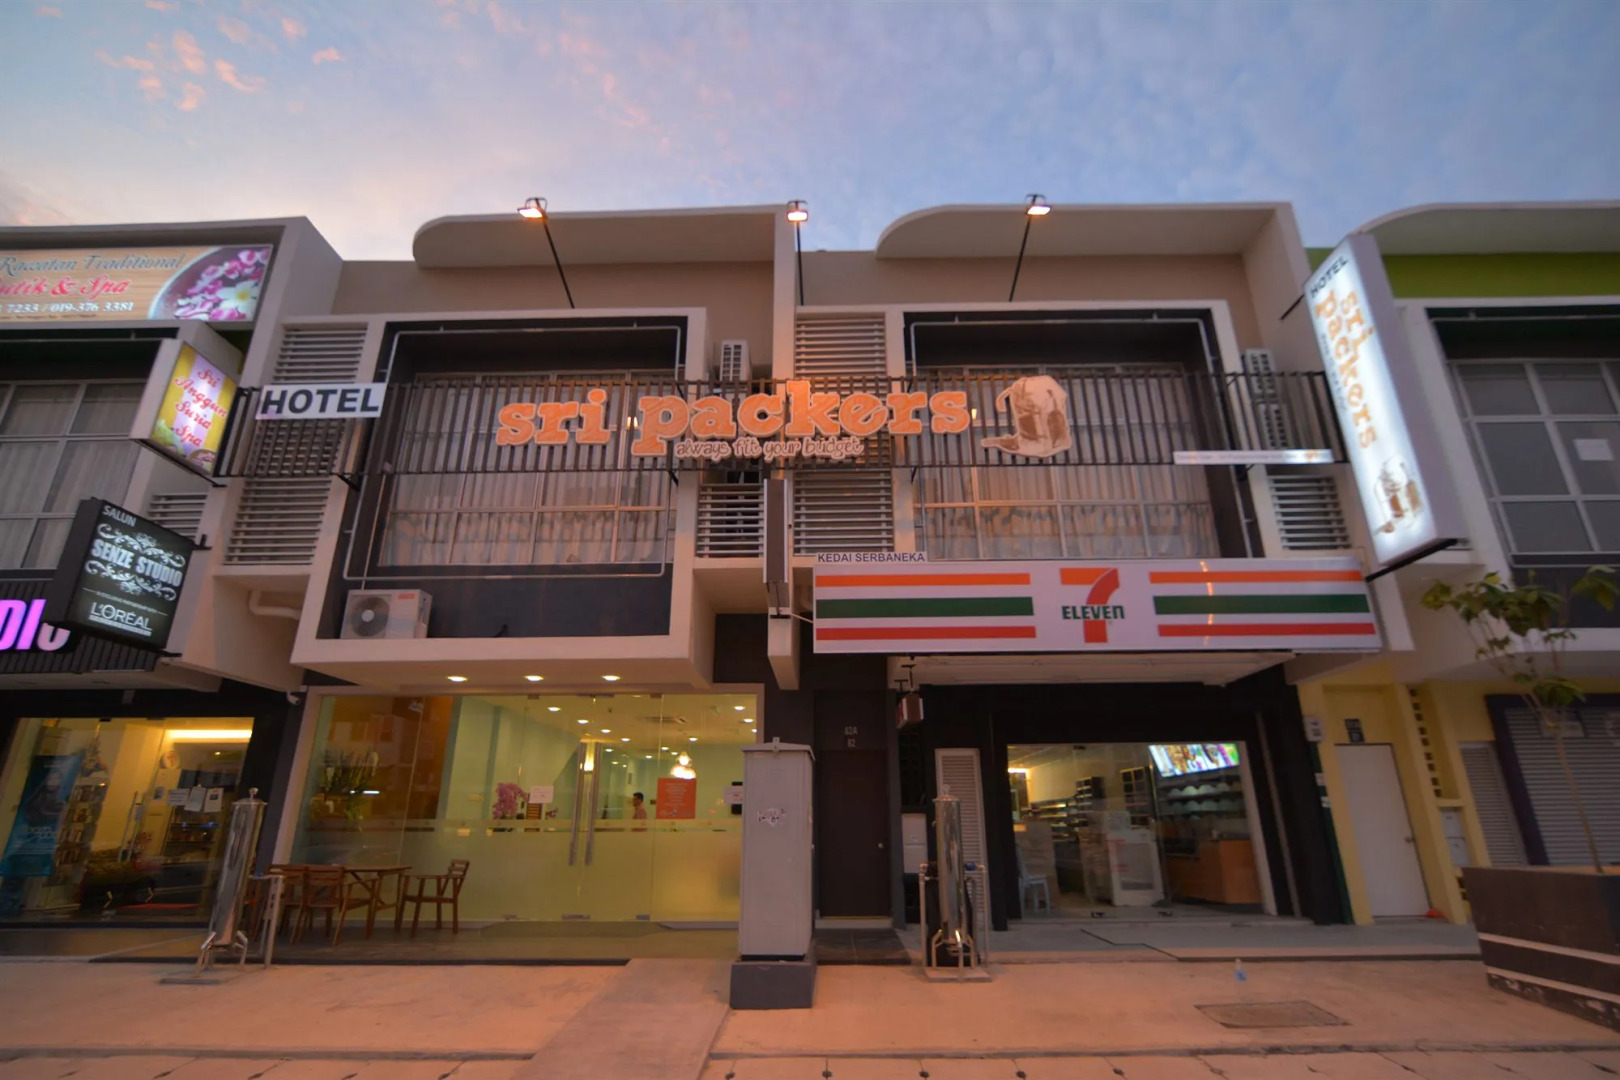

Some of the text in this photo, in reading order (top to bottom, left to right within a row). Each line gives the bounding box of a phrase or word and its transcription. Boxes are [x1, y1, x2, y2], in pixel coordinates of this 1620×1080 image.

[0, 253, 186, 276] Rawatan Traditional
[1310, 256, 1348, 297] HOTEL
[0, 274, 131, 300] utik & Spa
[1341, 291, 1375, 353] sri
[197, 369, 221, 388] Sri
[1315, 290, 1377, 448] packers
[174, 377, 227, 417] Anggun
[260, 388, 380, 415] HOTEL
[175, 401, 212, 429] Suria
[495, 380, 971, 456] sri packers
[174, 425, 203, 447] Spa
[675, 436, 864, 460] always fit your budget
[102, 504, 137, 527] SALUN
[91, 539, 183, 587] SENZE STUDIO
[817, 552, 925, 563] KEDAI SERBANEKA
[90, 602, 153, 631] L'ORÉAL
[1059, 567, 1120, 643] 7
